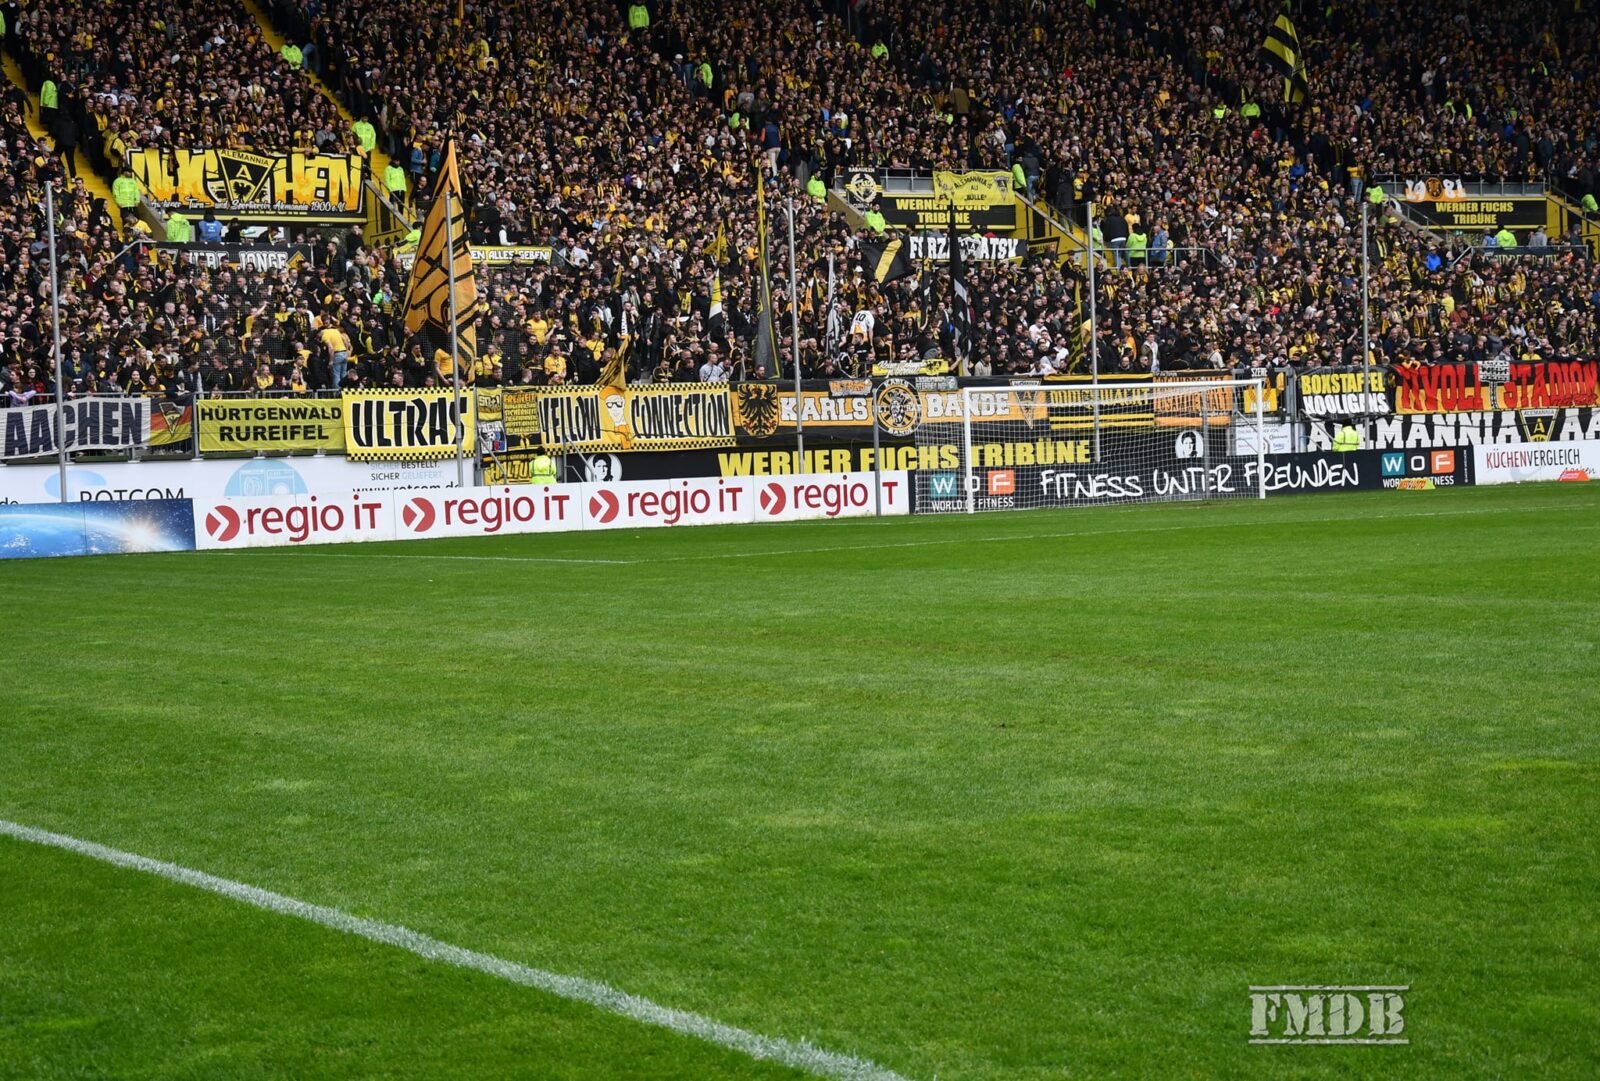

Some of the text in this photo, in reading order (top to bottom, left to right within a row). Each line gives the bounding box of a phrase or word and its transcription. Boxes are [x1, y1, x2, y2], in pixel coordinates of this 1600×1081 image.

[220, 149, 270, 166] ALEMANNIA
[236, 165, 253, 181] A
[311, 201, 331, 212] 1900
[1436, 201, 1514, 213] WERNER FUCHS
[1453, 213, 1497, 225] TRIBÜNE
[488, 250, 514, 261] ALLES
[1301, 372, 1386, 395] BOXSTAFEL
[1504, 361, 1598, 409] STADION
[201, 405, 342, 422] HÜRTGENWALD
[539, 391, 730, 444] YELLOW CONNECTION
[780, 395, 868, 422] KARLS
[5, 401, 142, 456] AACHEN
[219, 424, 329, 442] RUREIFEL
[352, 396, 468, 447] ULTRAS
[718, 436, 1091, 478] WERNER FUCHS TRIBÜNE
[1486, 448, 1580, 469] KÜCHENVERGLEICH
[371, 472, 400, 481] SICHER
[1040, 457, 1359, 499] FITNESS UNTER FREUNDEN
[628, 479, 743, 525] regio iT
[793, 474, 868, 516] regio
[978, 497, 1014, 509] FITNESS
[247, 494, 382, 542] regio iT
[444, 486, 570, 532] regio iT
